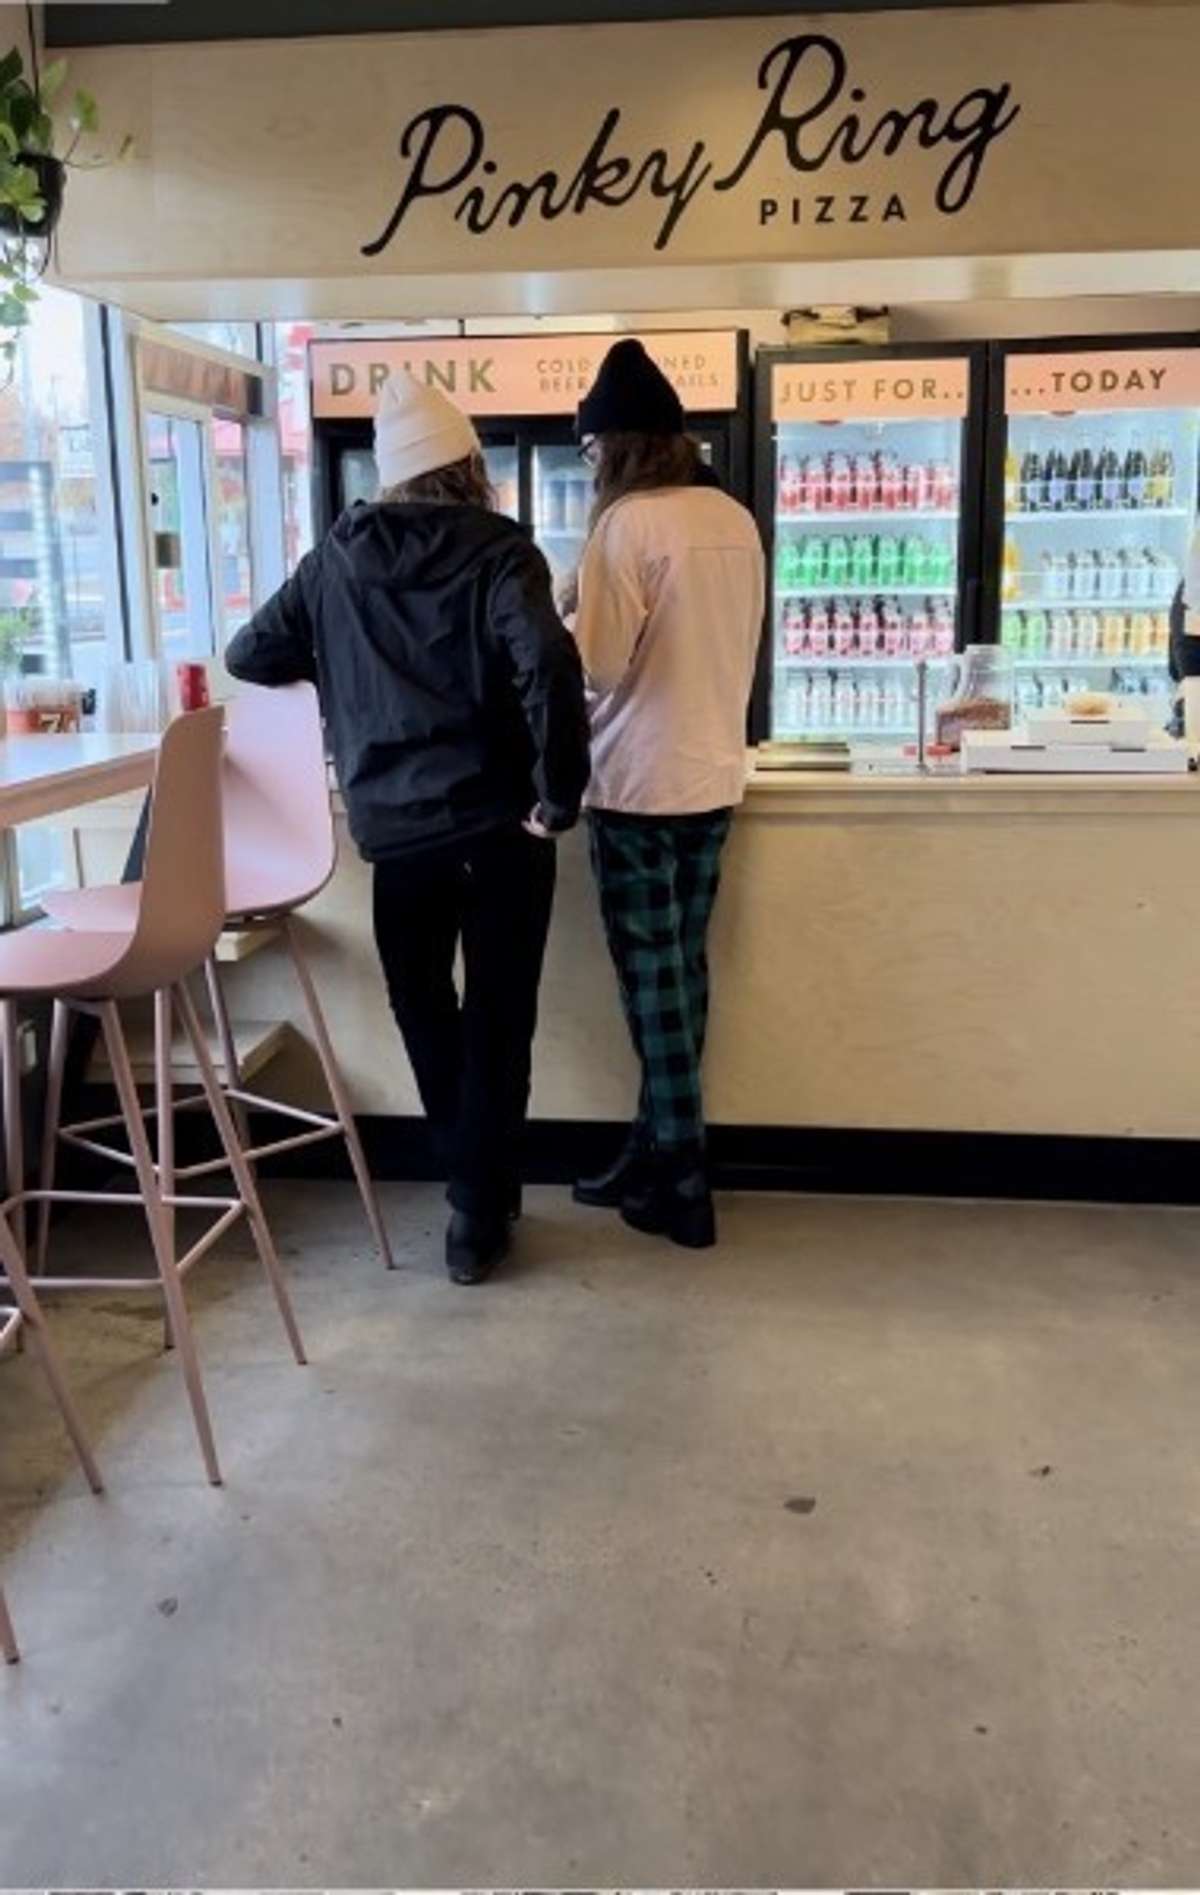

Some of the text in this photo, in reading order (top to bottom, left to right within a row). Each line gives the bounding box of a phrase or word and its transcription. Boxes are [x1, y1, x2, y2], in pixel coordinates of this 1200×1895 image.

[361, 34, 1020, 256] Pinky Ring
[759, 194, 907, 226] PIZZA
[329, 359, 496, 397] DRNK
[537, 359, 589, 374] COLD
[781, 378, 857, 404] JUST
